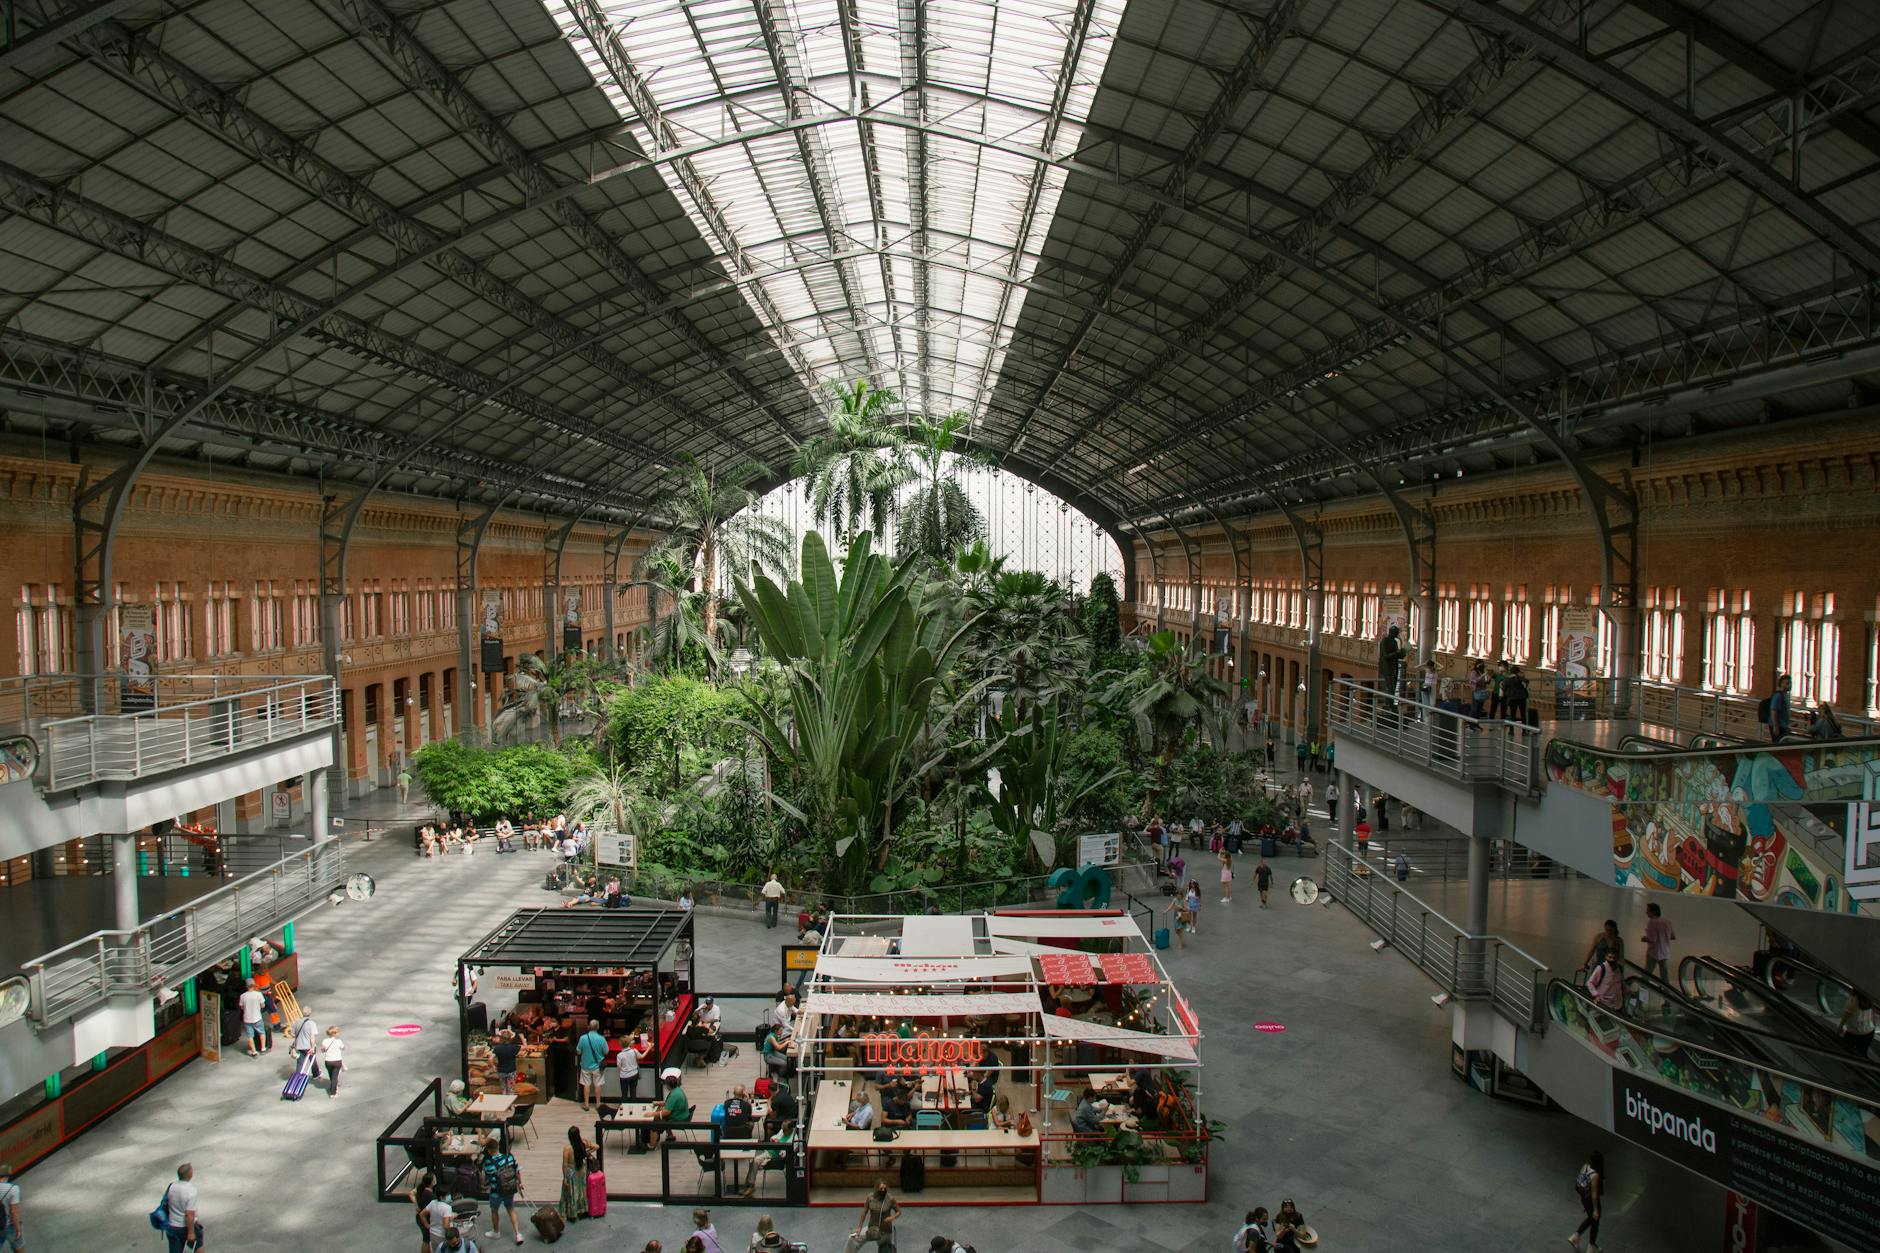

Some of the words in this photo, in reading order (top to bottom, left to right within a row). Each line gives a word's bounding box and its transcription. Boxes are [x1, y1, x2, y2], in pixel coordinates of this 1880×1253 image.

[864, 1032, 984, 1062] Mahou
[1625, 1087, 1717, 1154] bitpanda
[1783, 1158, 1824, 1182] totalidad
[1826, 1175, 1840, 1189] del
[1852, 1166, 1864, 1178] no
